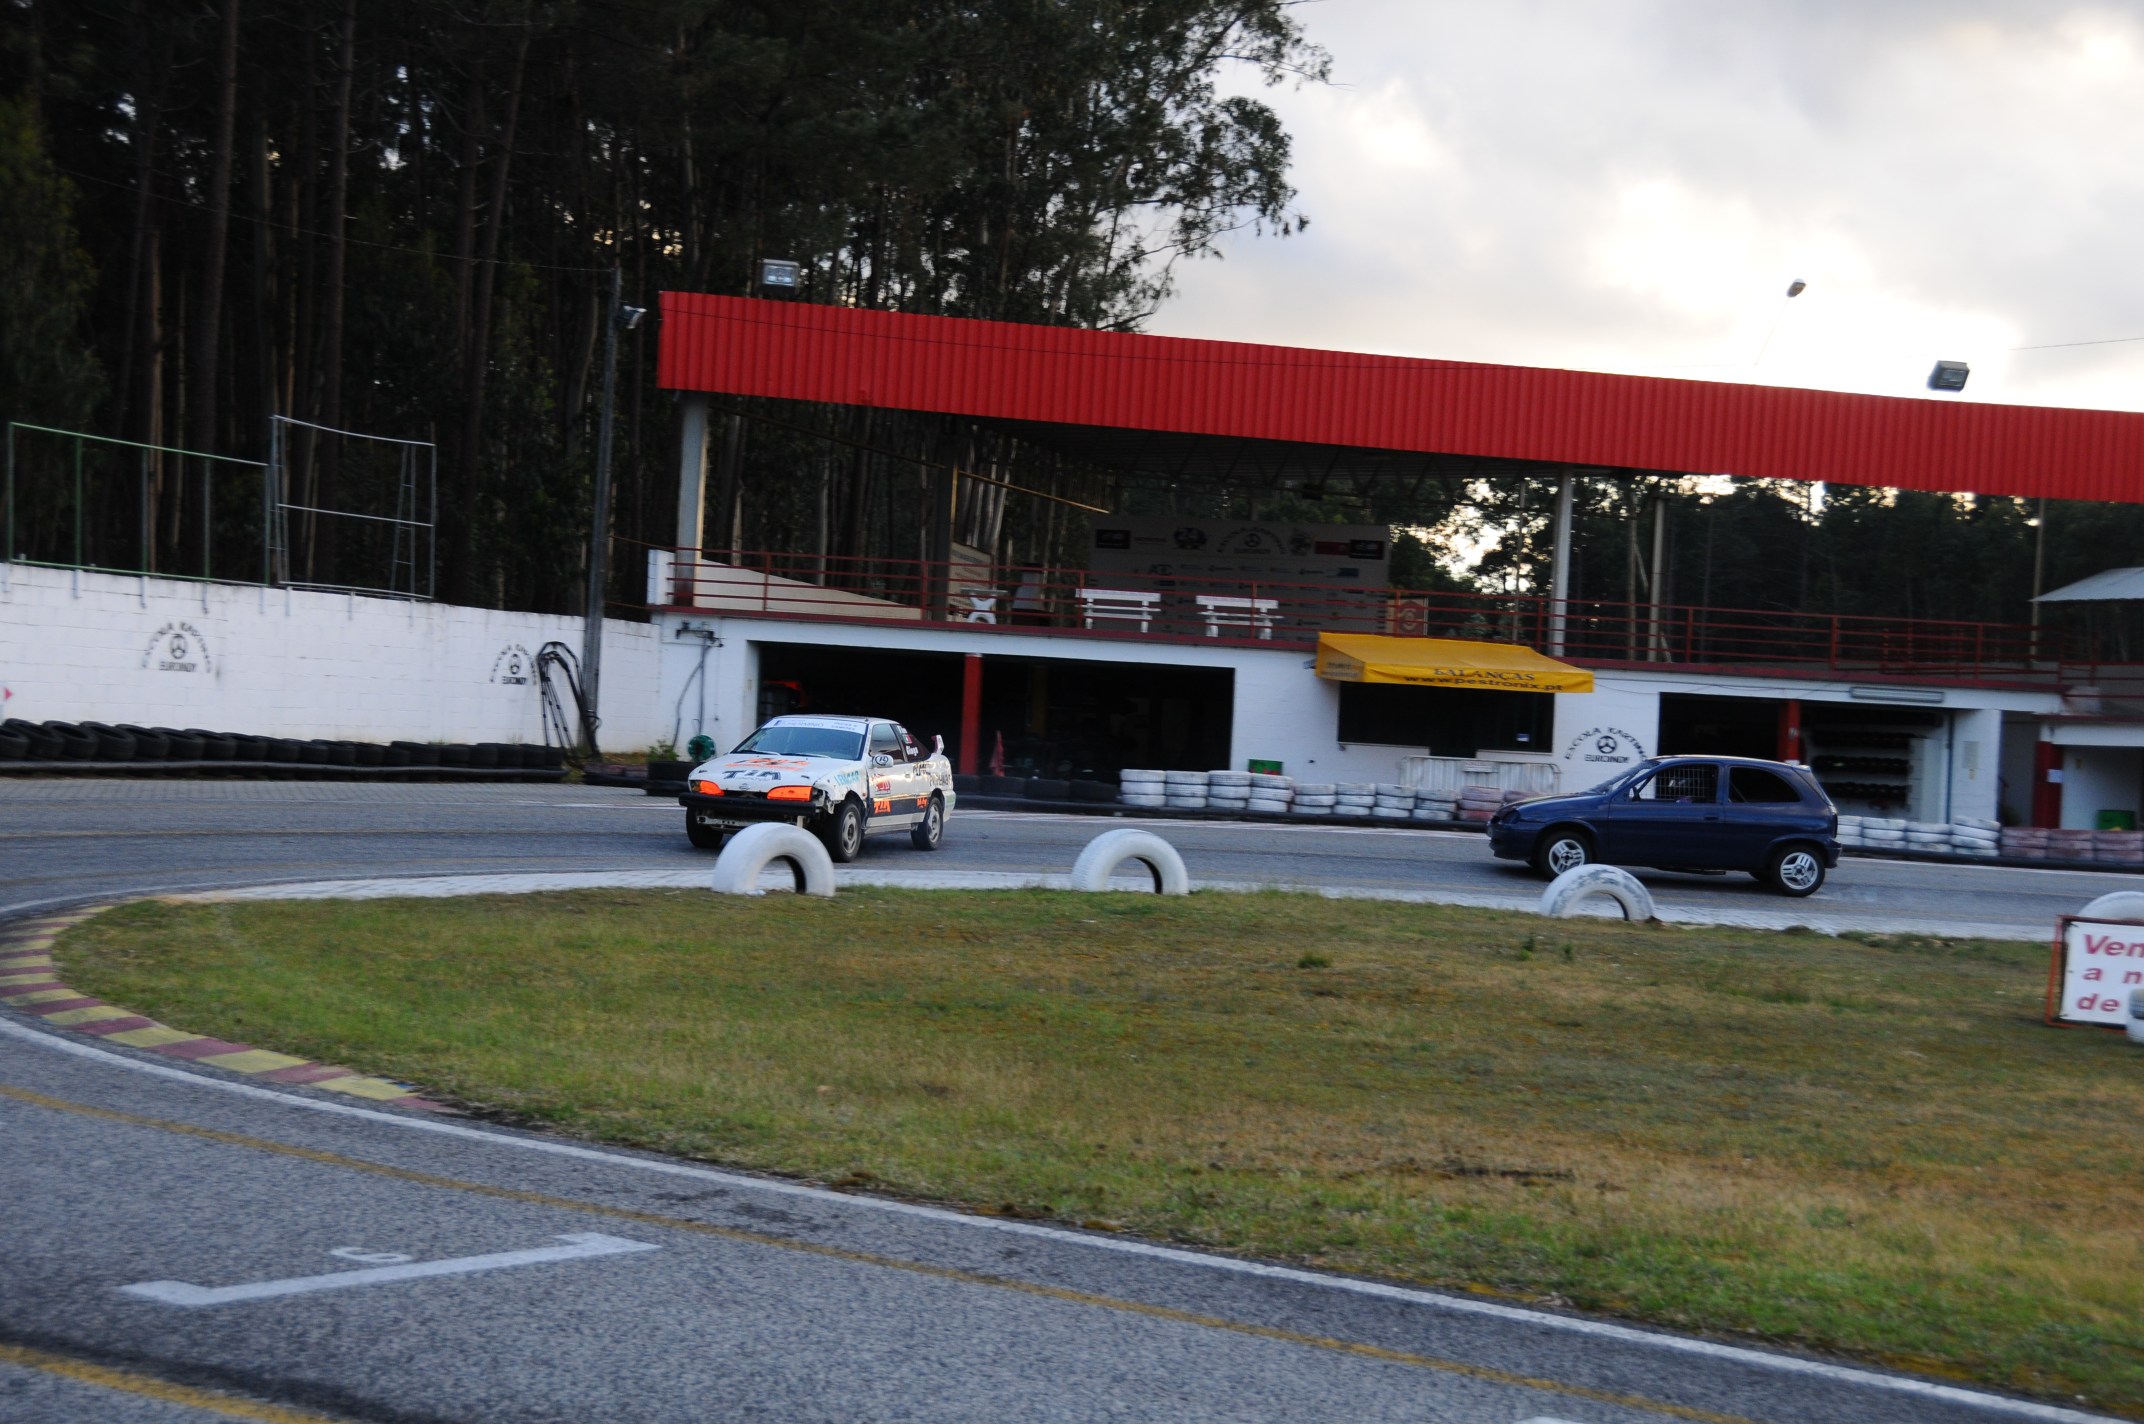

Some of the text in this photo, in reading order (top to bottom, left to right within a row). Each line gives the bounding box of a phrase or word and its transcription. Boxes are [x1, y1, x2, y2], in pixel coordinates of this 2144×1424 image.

[1404, 676, 1564, 691] www.pestronix.pt
[1564, 727, 1602, 760] ESCOLA
[2082, 967, 2102, 981] a
[2076, 993, 2120, 1012] de
